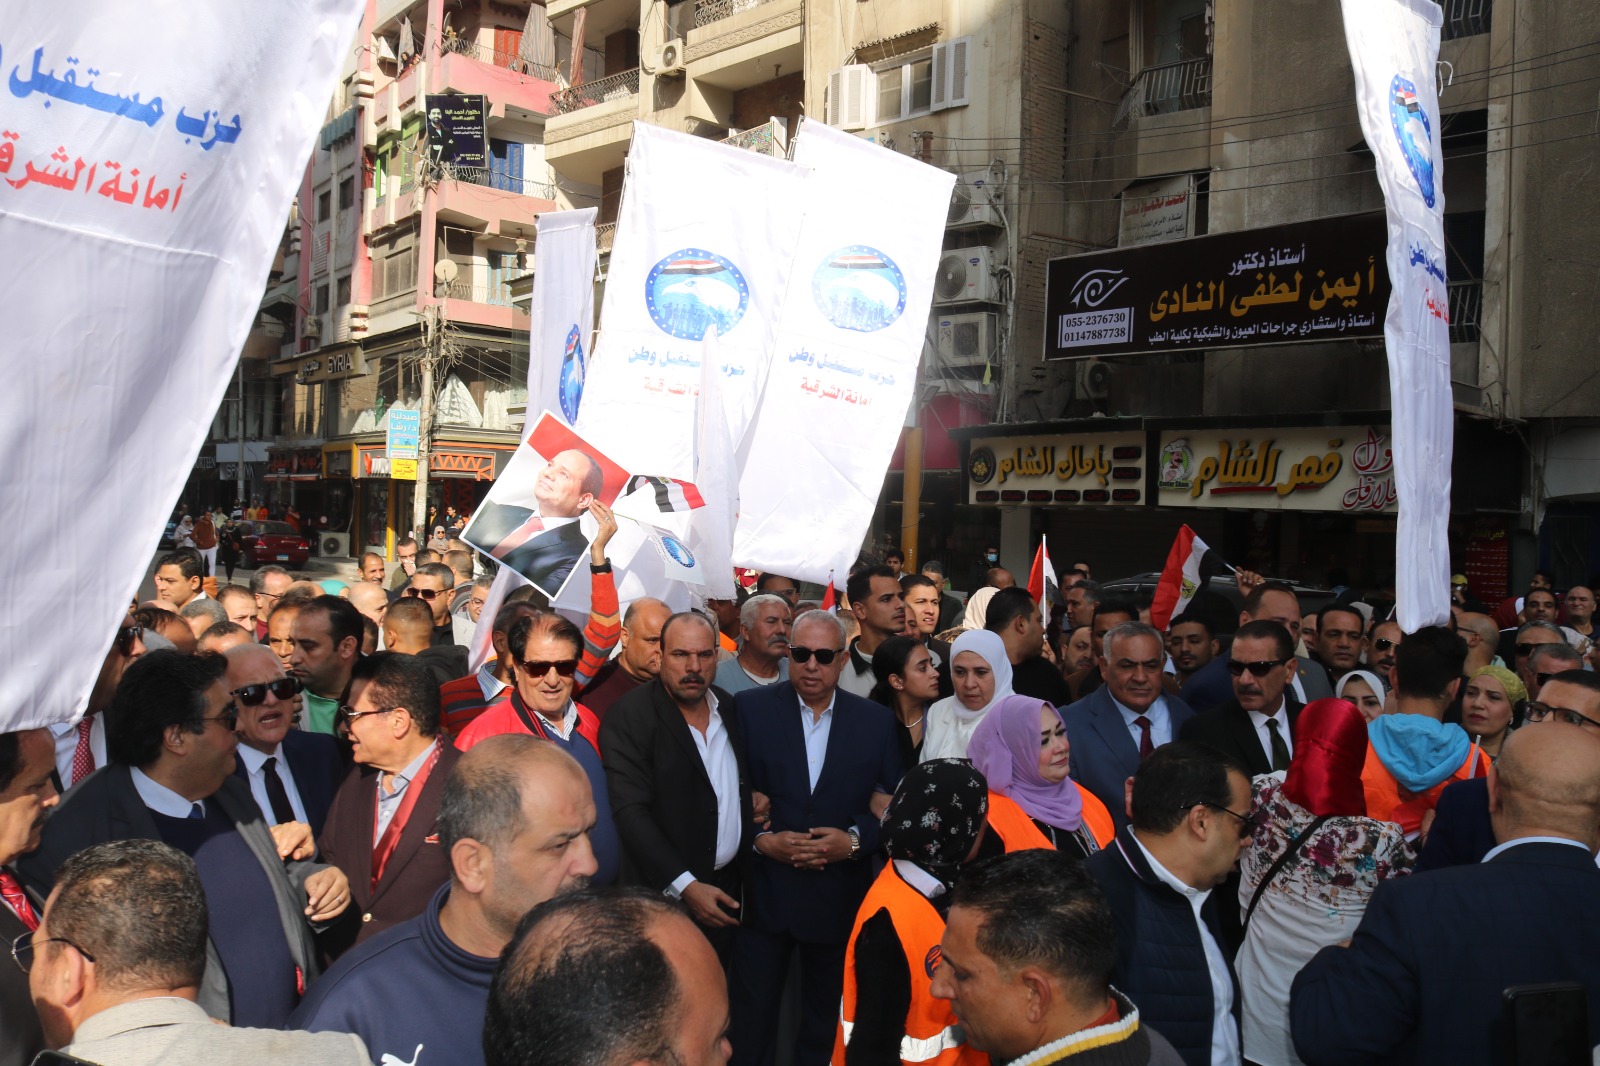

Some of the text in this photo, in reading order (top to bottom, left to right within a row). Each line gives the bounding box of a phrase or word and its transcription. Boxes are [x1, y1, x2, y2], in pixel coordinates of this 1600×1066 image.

[8, 46, 164, 128] مستقبل
[176, 106, 242, 151] حزب
[0, 130, 187, 214] أمانة الشرق
[1228, 243, 1305, 276] أستاذ دكتور
[1308, 255, 1375, 310] أيمن
[1150, 280, 1225, 322] النادى
[1064, 327, 1126, 342] 01147887738
[1066, 312, 1126, 328] 055-2376730
[1149, 312, 1375, 345] أستاذ واستشاري جراحات العيون والشبكية بكلية الطب
[327, 352, 353, 373] SYRIA
[659, 349, 700, 368] ستقبل
[788, 346, 815, 366] وطن
[817, 353, 864, 378] مستقبل
[800, 376, 845, 399] الشرقية
[391, 410, 417, 421] صيدلية
[997, 445, 1055, 485] الشام
[1353, 426, 1393, 473] ول
[1191, 438, 1342, 497] قمر الشام
